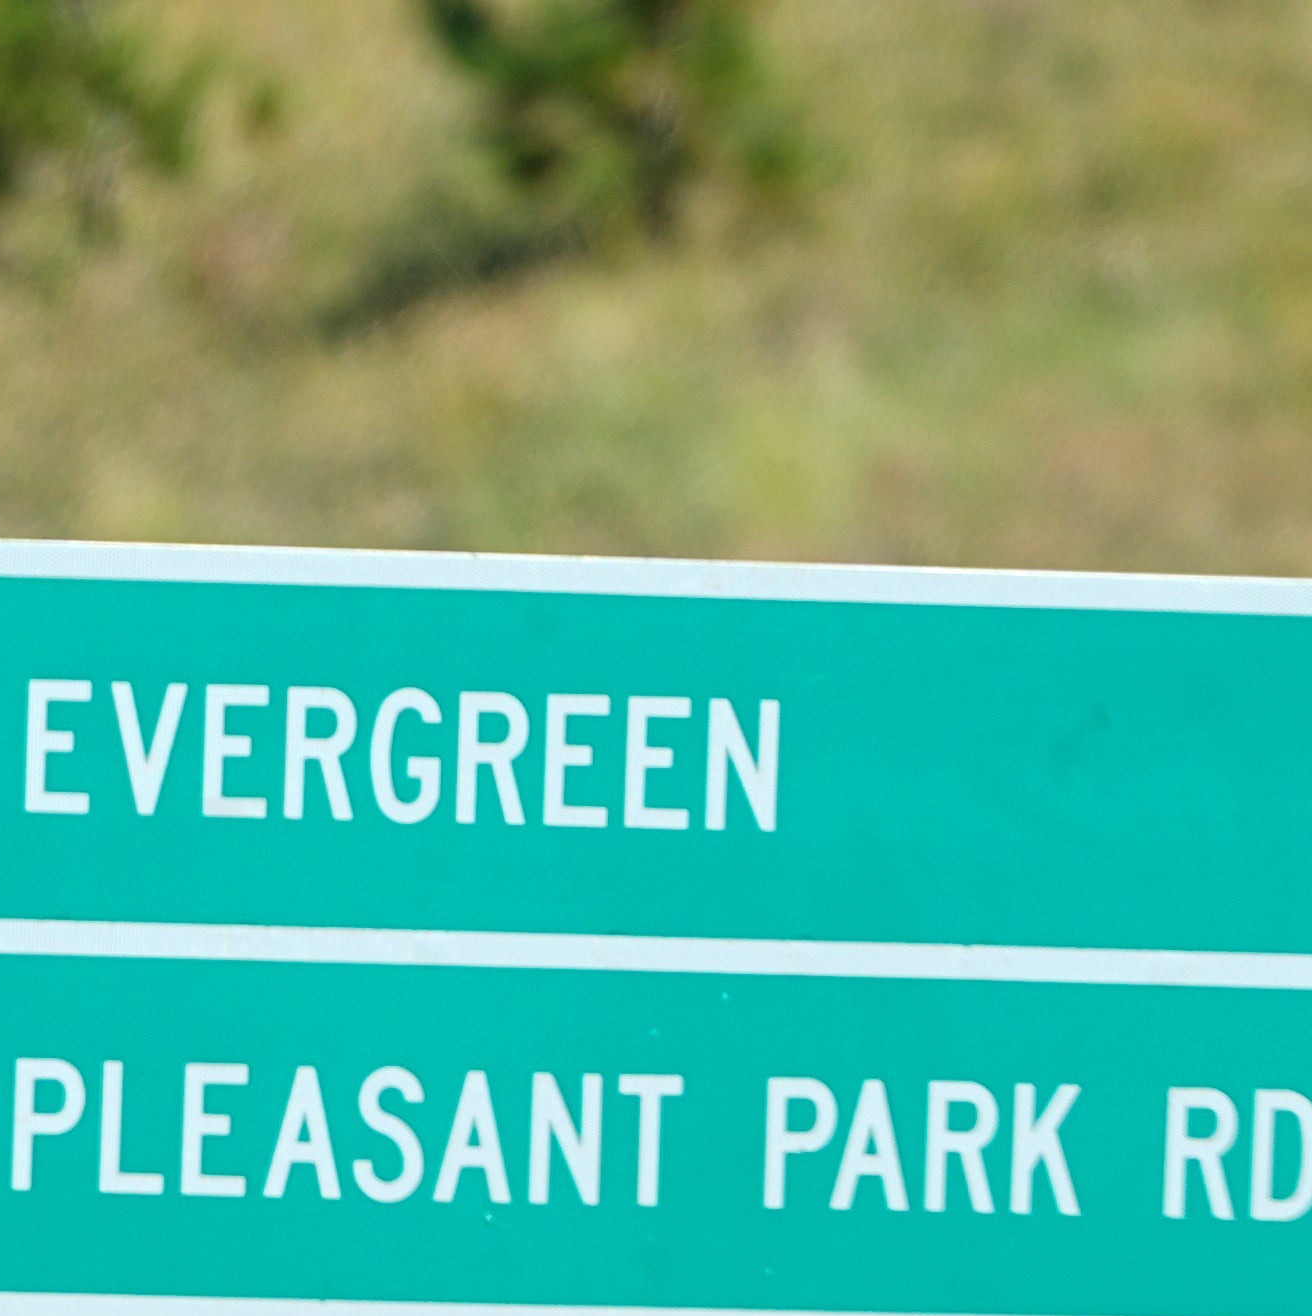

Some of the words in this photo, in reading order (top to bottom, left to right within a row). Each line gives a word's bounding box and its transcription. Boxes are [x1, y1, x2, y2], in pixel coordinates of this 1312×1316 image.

[24, 678, 780, 832] EVERGREEN
[11, 1057, 684, 1207] PLEASANT
[763, 1077, 1081, 1216] PARK
